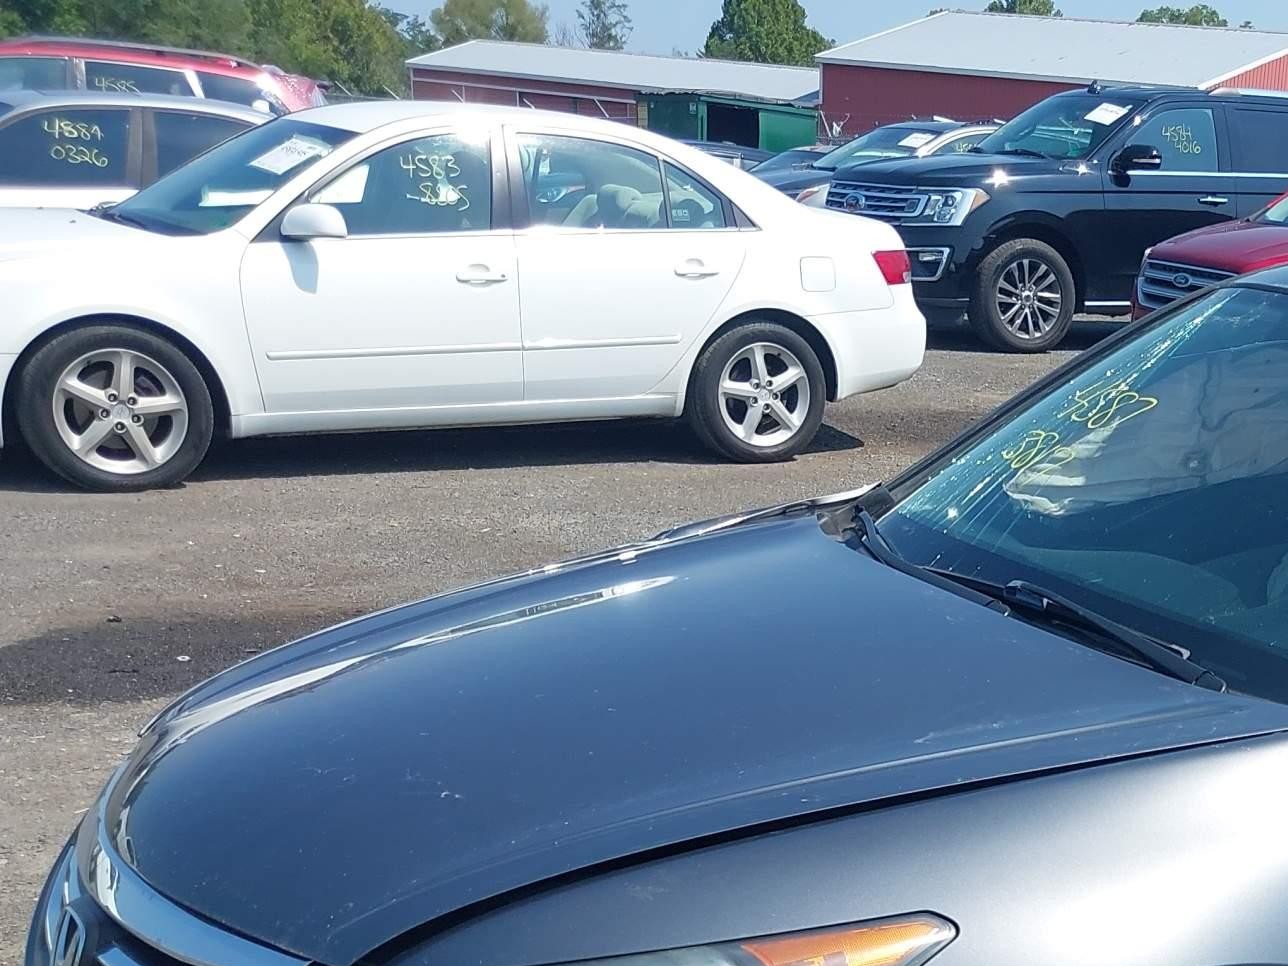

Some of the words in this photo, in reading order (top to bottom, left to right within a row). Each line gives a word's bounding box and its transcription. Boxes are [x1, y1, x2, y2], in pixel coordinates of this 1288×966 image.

[1161, 122, 1193, 142] 4584
[50, 144, 109, 168] 0326
[1173, 140, 1202, 154] 4016
[400, 154, 461, 179] 4583
